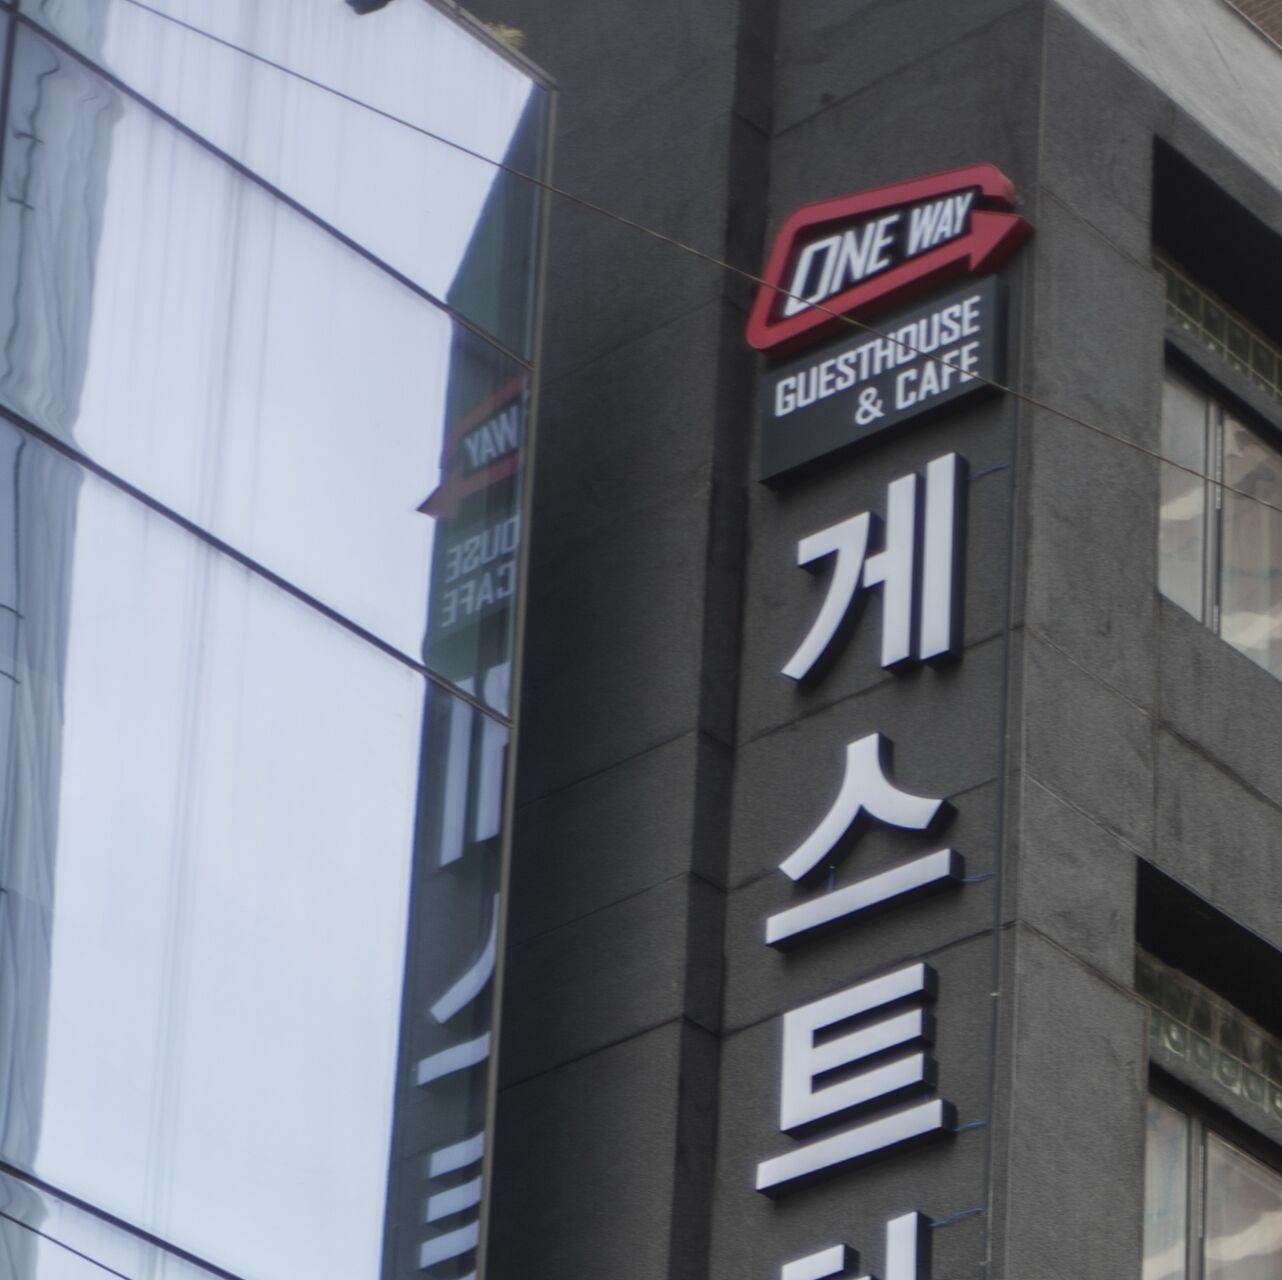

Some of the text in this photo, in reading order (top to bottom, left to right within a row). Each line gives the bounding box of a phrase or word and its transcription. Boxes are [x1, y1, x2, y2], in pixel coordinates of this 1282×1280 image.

[783, 192, 975, 318] ONE WAY
[774, 294, 982, 418] GUESTHOUSE
[854, 341, 981, 426] & CAFE
